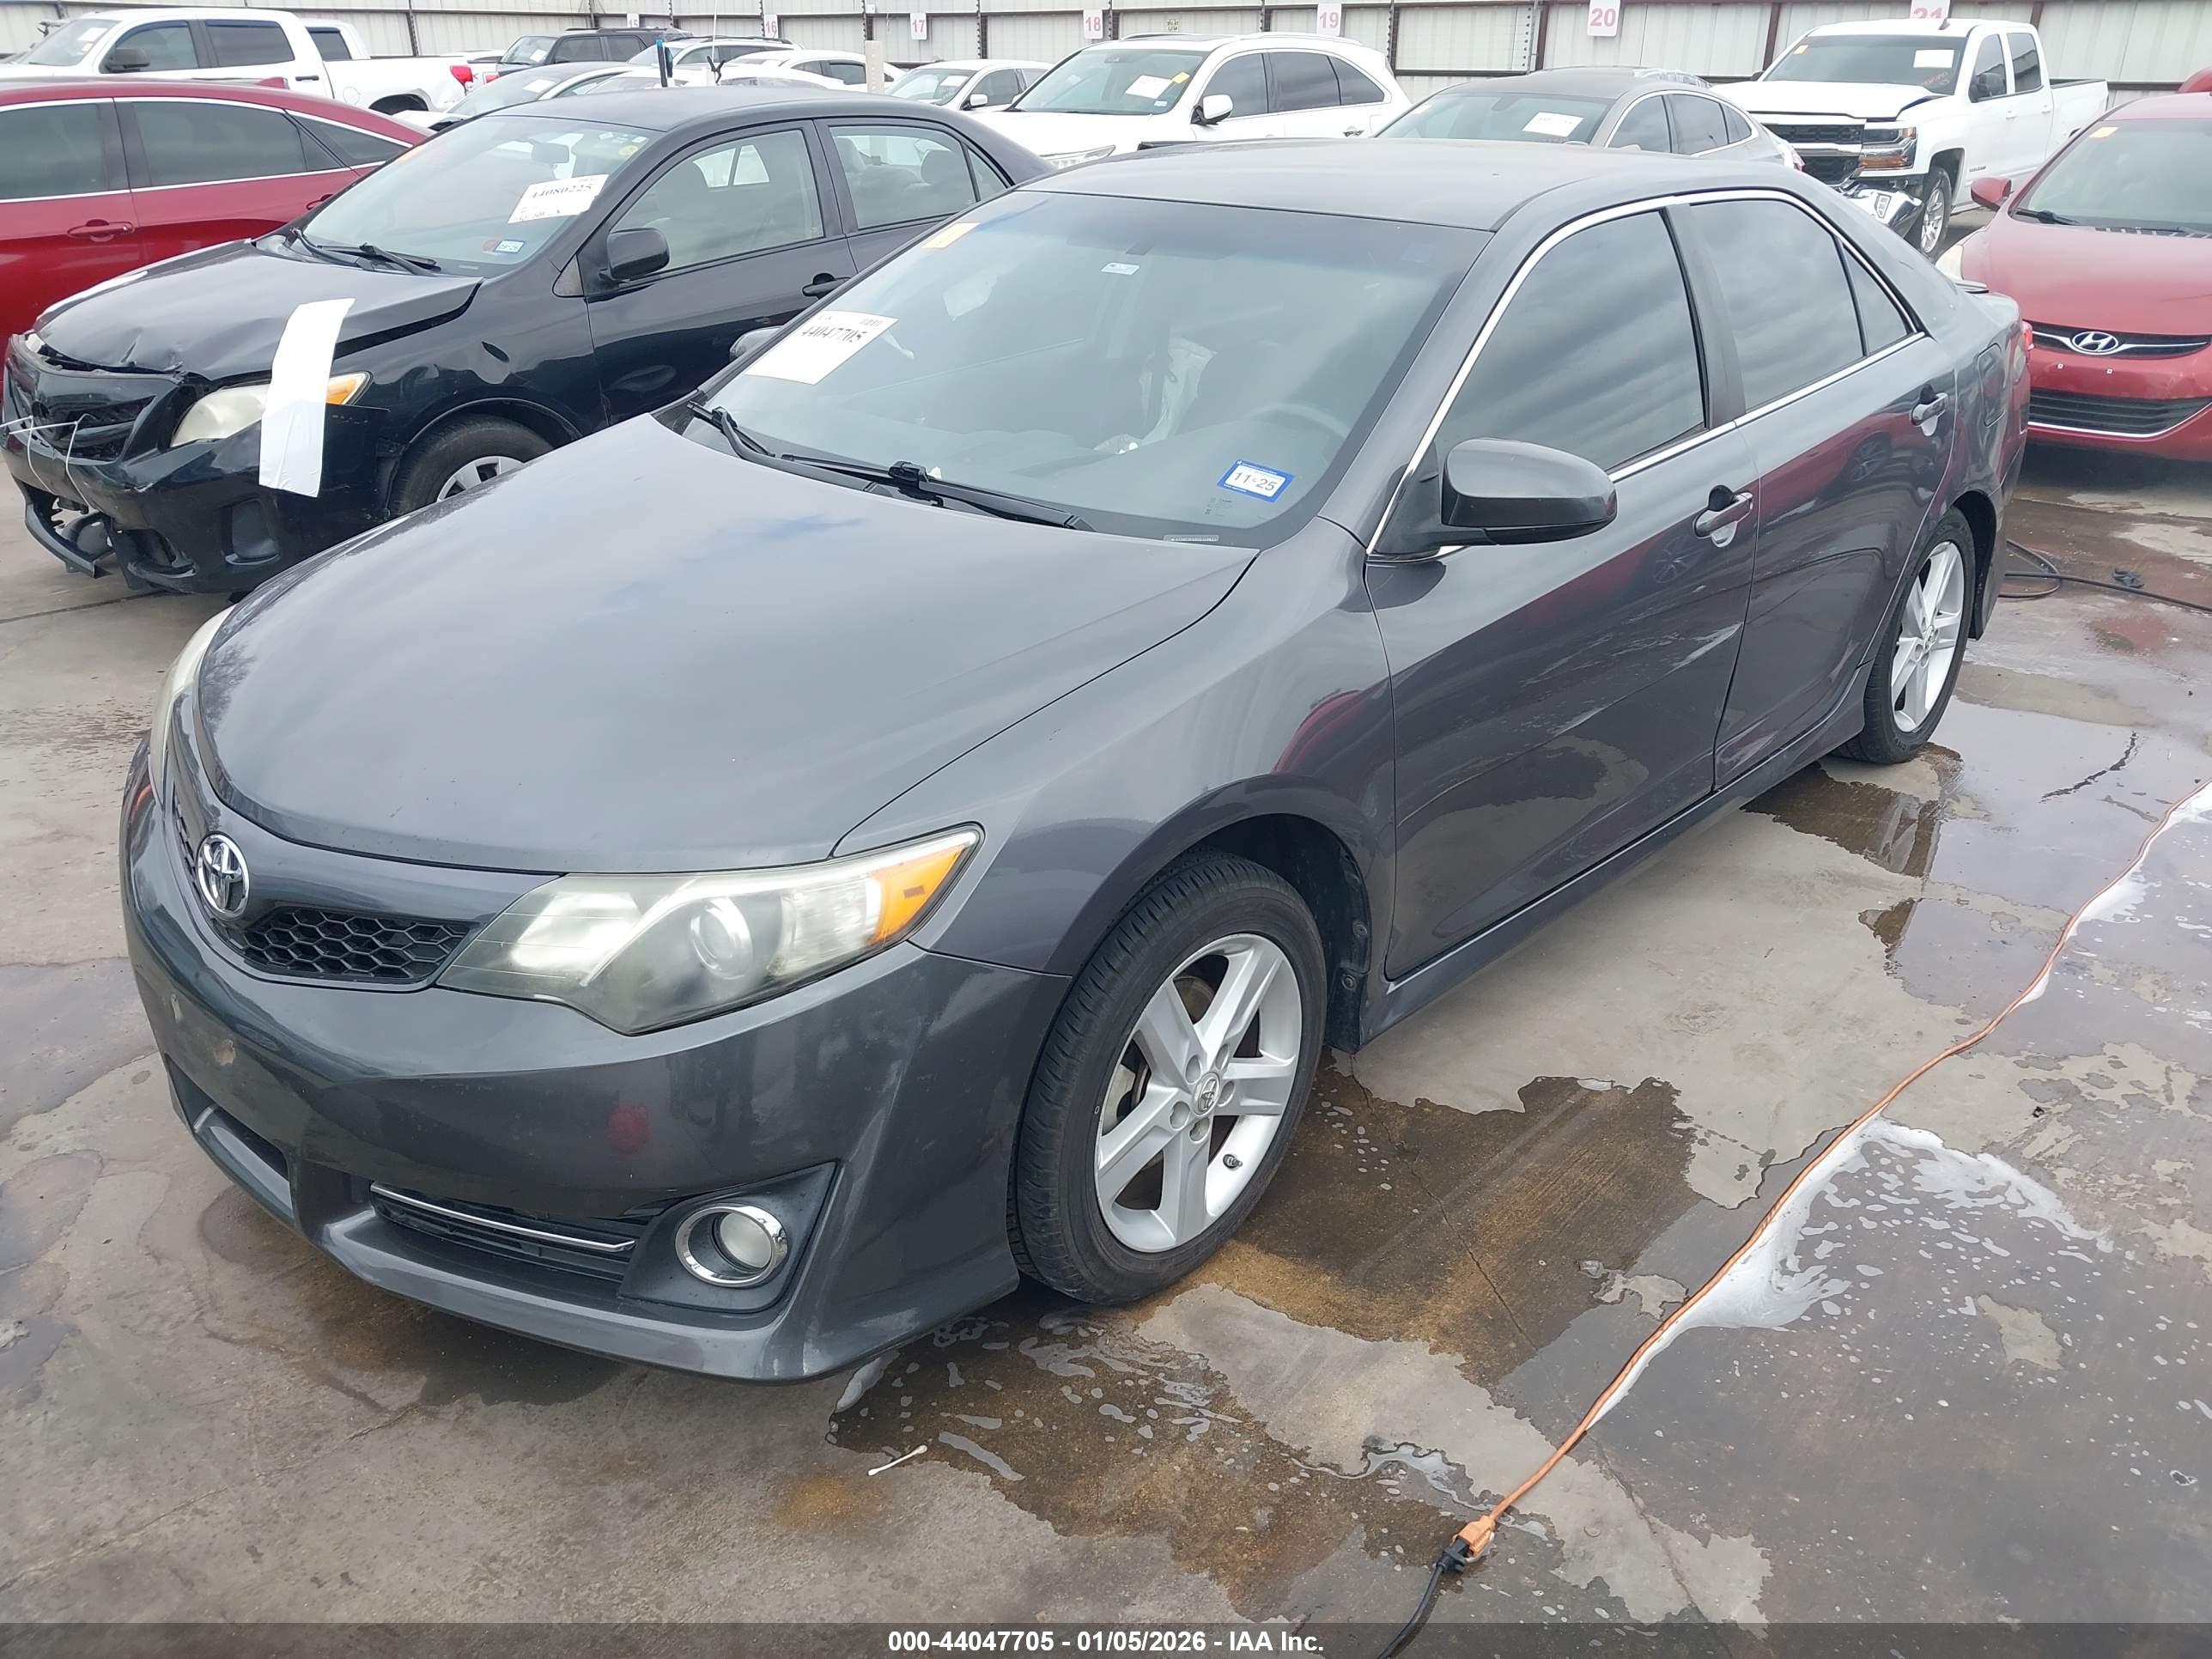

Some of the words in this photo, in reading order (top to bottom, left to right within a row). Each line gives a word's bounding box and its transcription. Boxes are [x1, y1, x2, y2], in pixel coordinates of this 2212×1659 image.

[1085, 16, 1102, 32] 18
[1320, 12, 1339, 28] 19
[1590, 8, 1616, 27] 20
[765, 21, 777, 33] 16
[912, 21, 926, 33] 17
